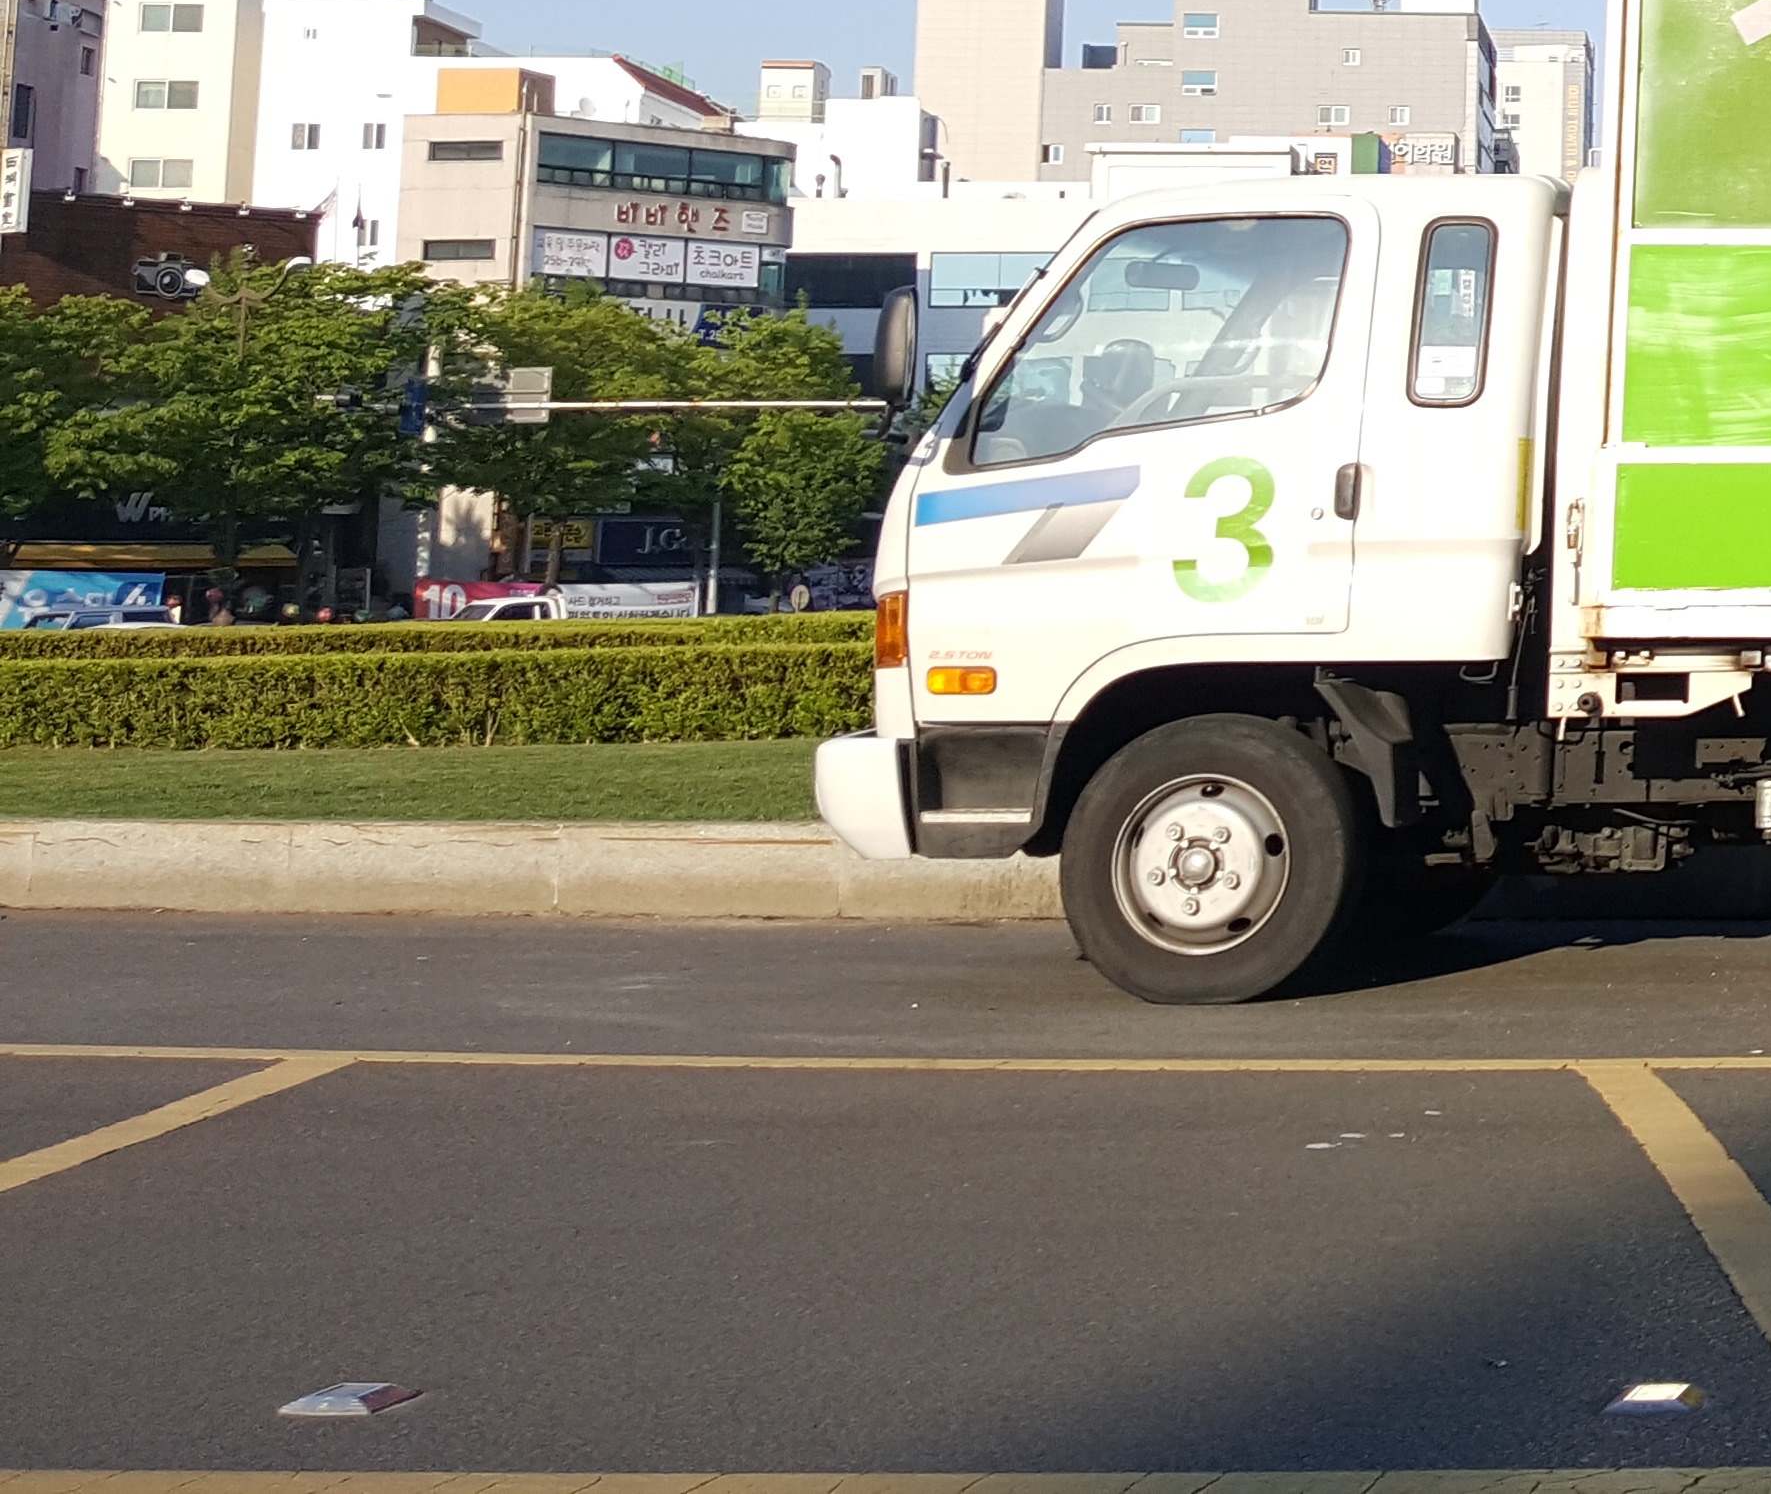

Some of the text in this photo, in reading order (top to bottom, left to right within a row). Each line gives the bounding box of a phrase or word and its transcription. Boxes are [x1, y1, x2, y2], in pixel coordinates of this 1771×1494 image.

[639, 261, 680, 277] 그라피
[692, 245, 753, 269] 초크아트
[699, 270, 745, 281] chalkart
[1172, 455, 1276, 603] 3
[422, 583, 467, 619] 10
